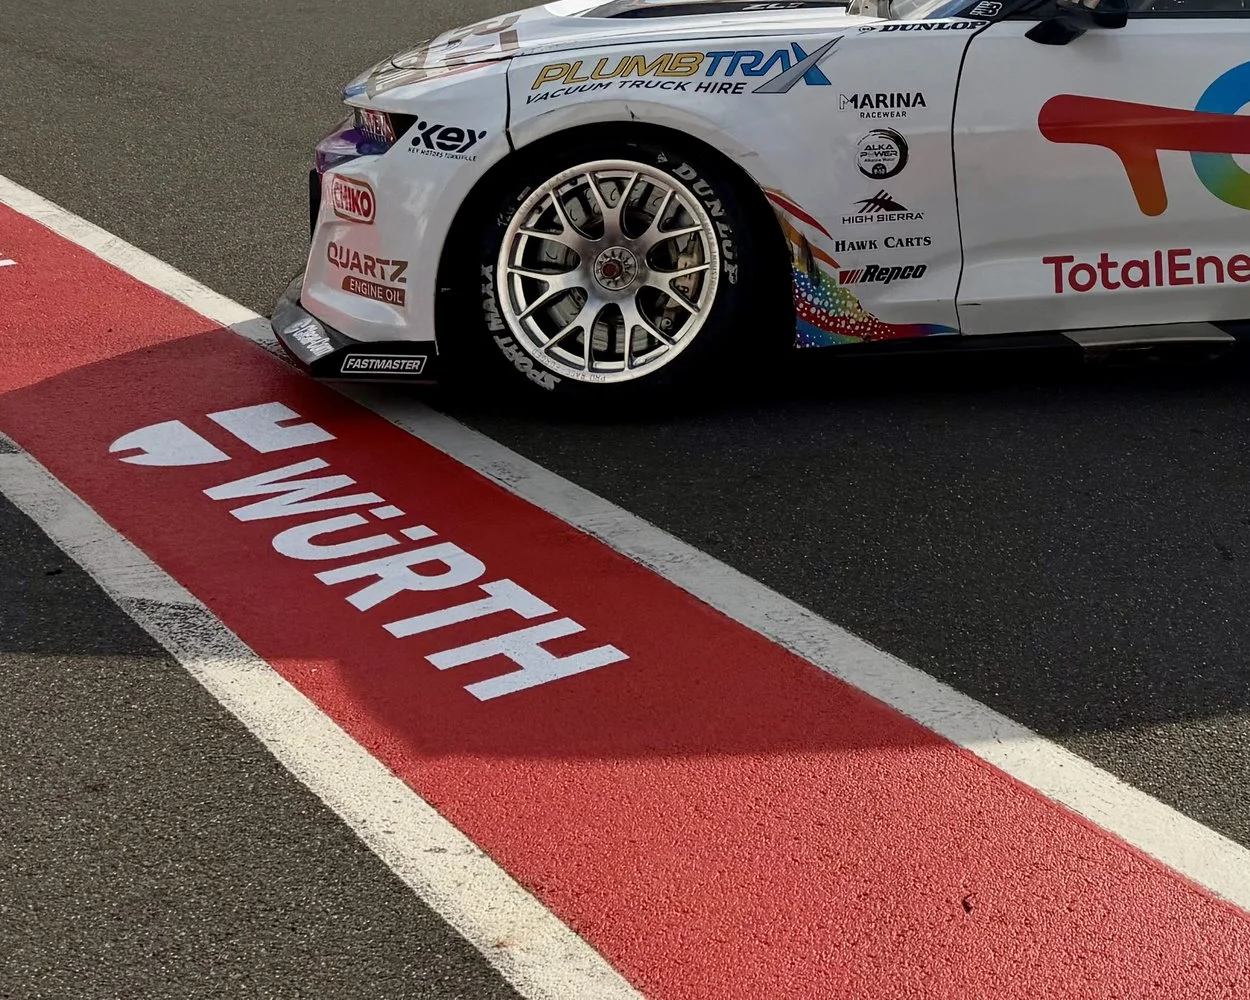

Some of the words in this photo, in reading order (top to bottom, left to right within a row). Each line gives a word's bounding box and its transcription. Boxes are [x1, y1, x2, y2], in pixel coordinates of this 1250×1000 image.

[879, 21, 987, 32] DUNLOP
[531, 35, 844, 94] PLUMBTRAX
[526, 80, 610, 105] VACUUM
[618, 80, 695, 93] TRUCK
[696, 81, 747, 96] HIRE
[839, 92, 927, 110] MARINA
[860, 111, 907, 119] RACEWEAR
[334, 181, 370, 218] CHIKO
[671, 162, 738, 285] DUNLOP
[842, 215, 873, 225] HIGH
[877, 212, 924, 223] SIERRA
[327, 241, 409, 284] QUARTZ
[859, 264, 927, 284] Repco
[350, 277, 384, 299] ENGINE
[385, 287, 403, 304] OIL
[480, 264, 506, 331] MAXX
[346, 357, 421, 371] FASTMASTER
[493, 335, 562, 391] SPORT
